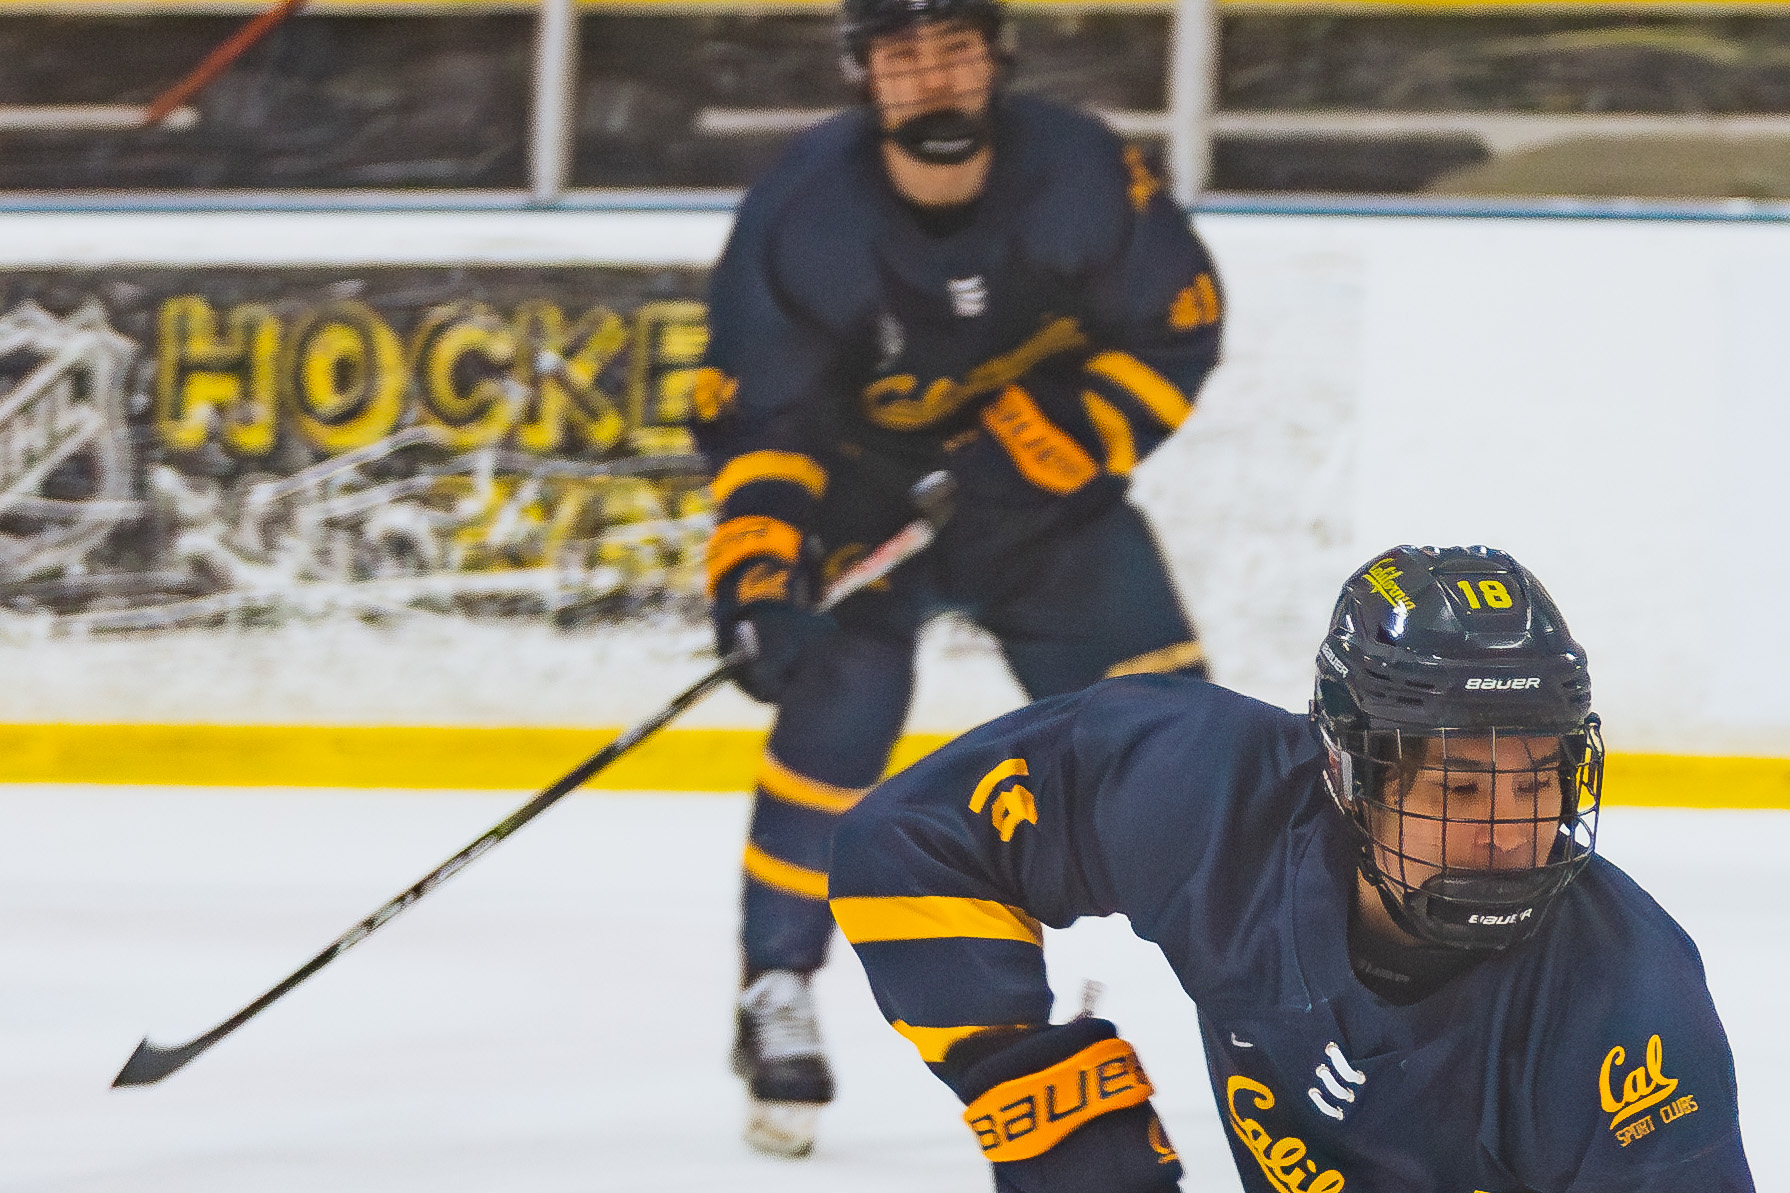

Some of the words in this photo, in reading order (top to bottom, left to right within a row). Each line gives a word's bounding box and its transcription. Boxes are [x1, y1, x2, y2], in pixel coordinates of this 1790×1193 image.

[1457, 579, 1513, 610] 18
[1464, 676, 1542, 691] BAUER
[1600, 1033, 1679, 1131] Cal
[1615, 1115, 1656, 1147] SPORT
